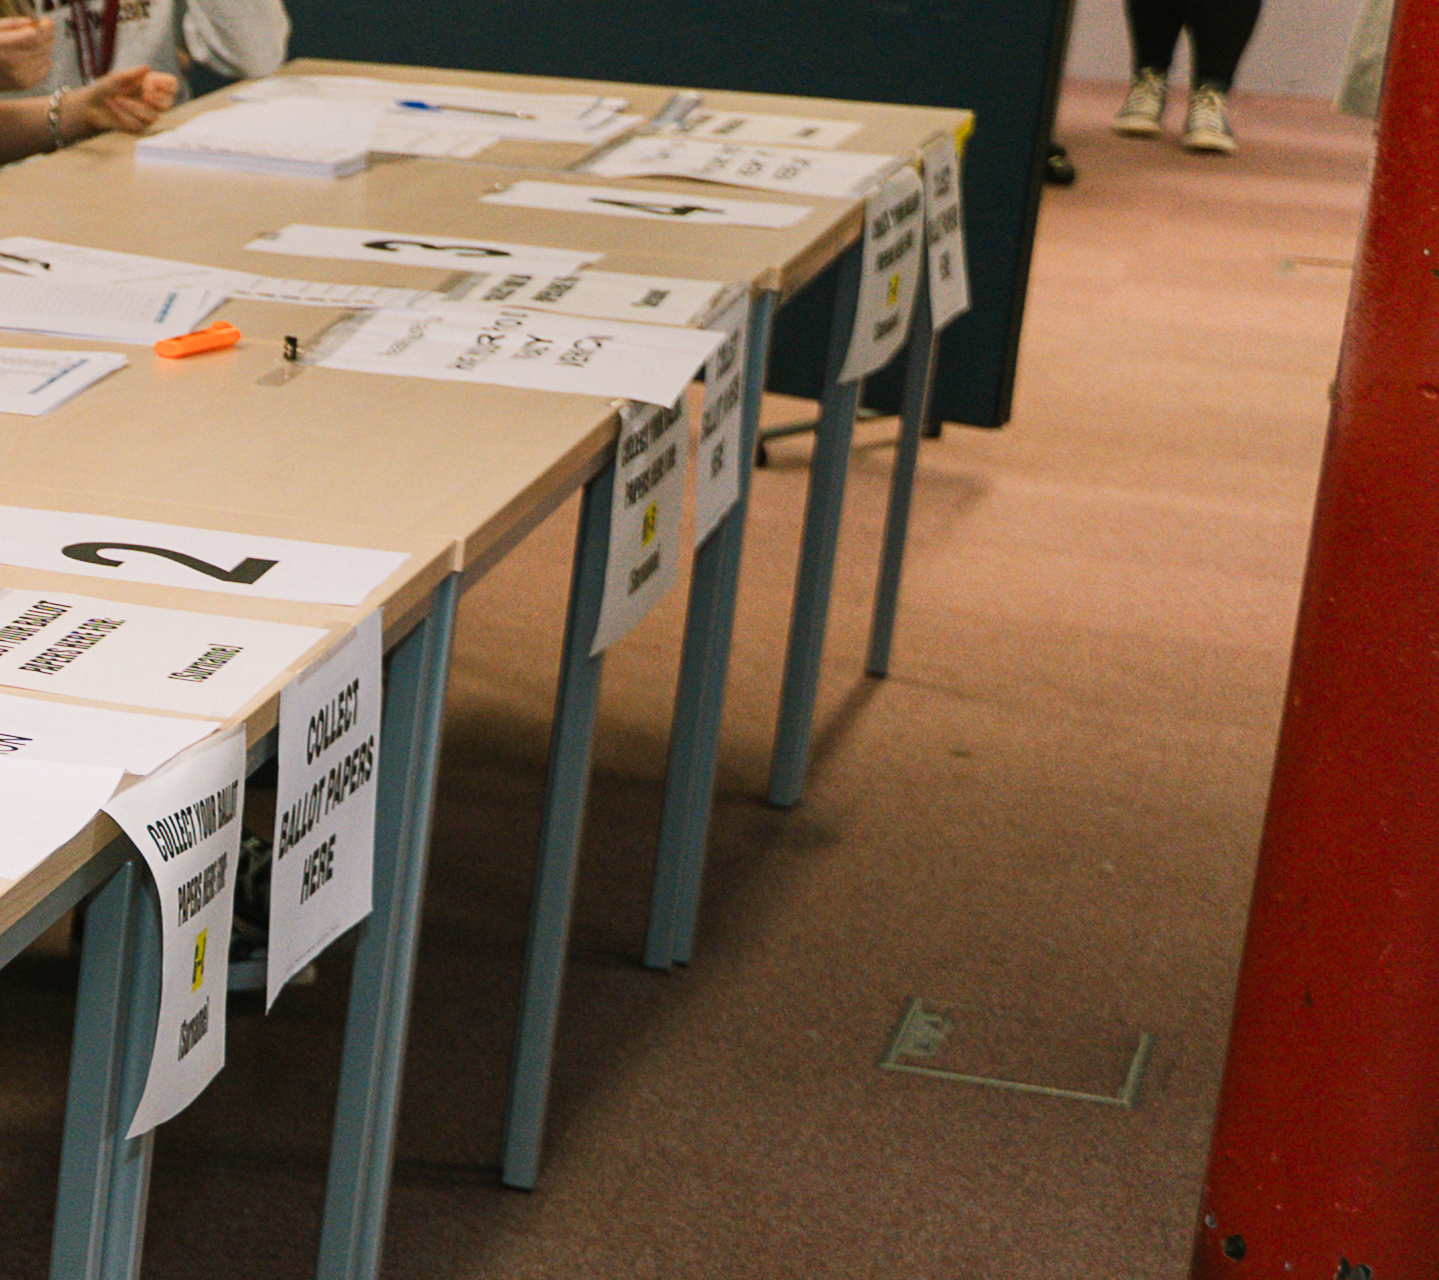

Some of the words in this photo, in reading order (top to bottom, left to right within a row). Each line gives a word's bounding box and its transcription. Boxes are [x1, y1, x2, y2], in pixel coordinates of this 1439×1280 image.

[588, 197, 725, 216] 4
[363, 239, 513, 258] 3
[61, 541, 280, 585] 2
[13, 600, 72, 627] BALLOT
[18, 648, 84, 675] PAPERS
[54, 631, 108, 651] HERE
[306, 678, 359, 765] COLLECT
[277, 775, 326, 861] BALLOT
[325, 735, 374, 815] PAPERS
[147, 806, 197, 862] COLLECT
[193, 795, 216, 841] YOUR
[300, 833, 337, 905] HERE
